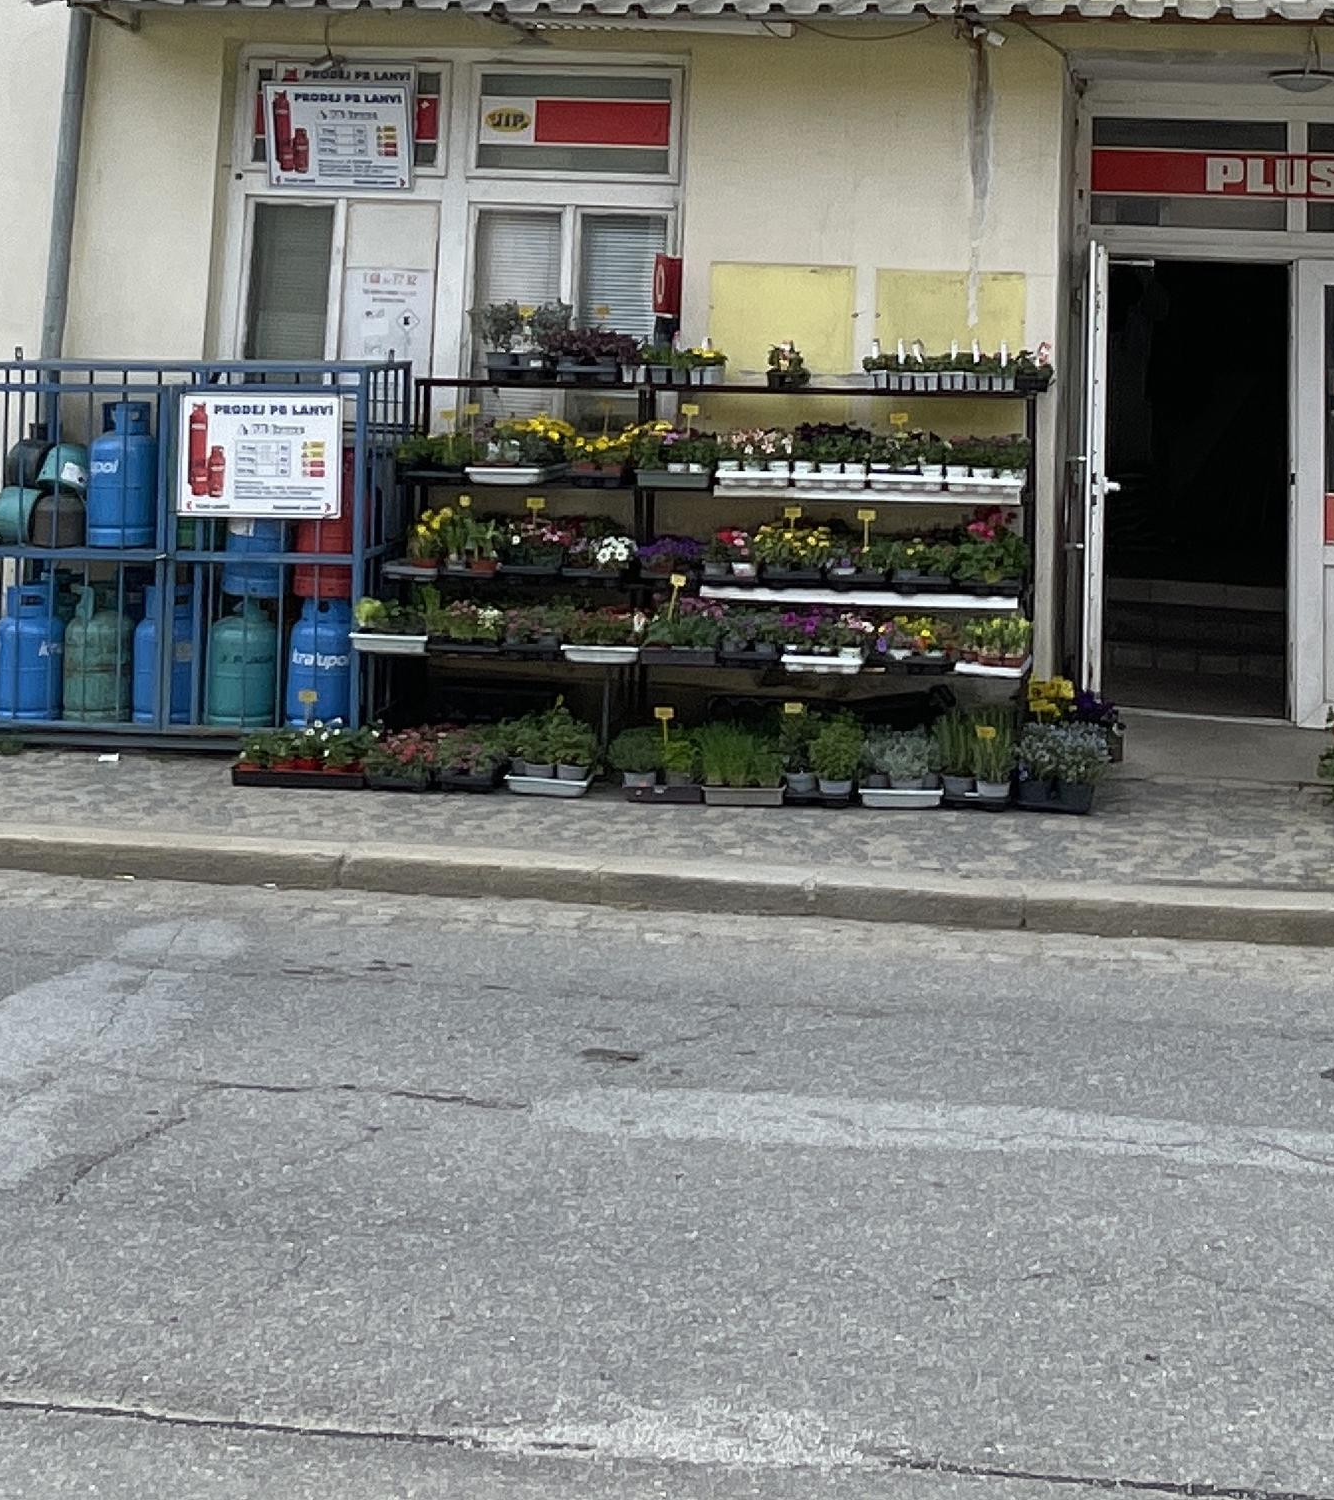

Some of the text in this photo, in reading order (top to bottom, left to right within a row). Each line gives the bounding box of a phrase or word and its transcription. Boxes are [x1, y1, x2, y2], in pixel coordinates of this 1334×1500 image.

[293, 92, 342, 103] PRODEJ
[487, 111, 525, 128] JIP
[213, 404, 266, 415] PRODEJ
